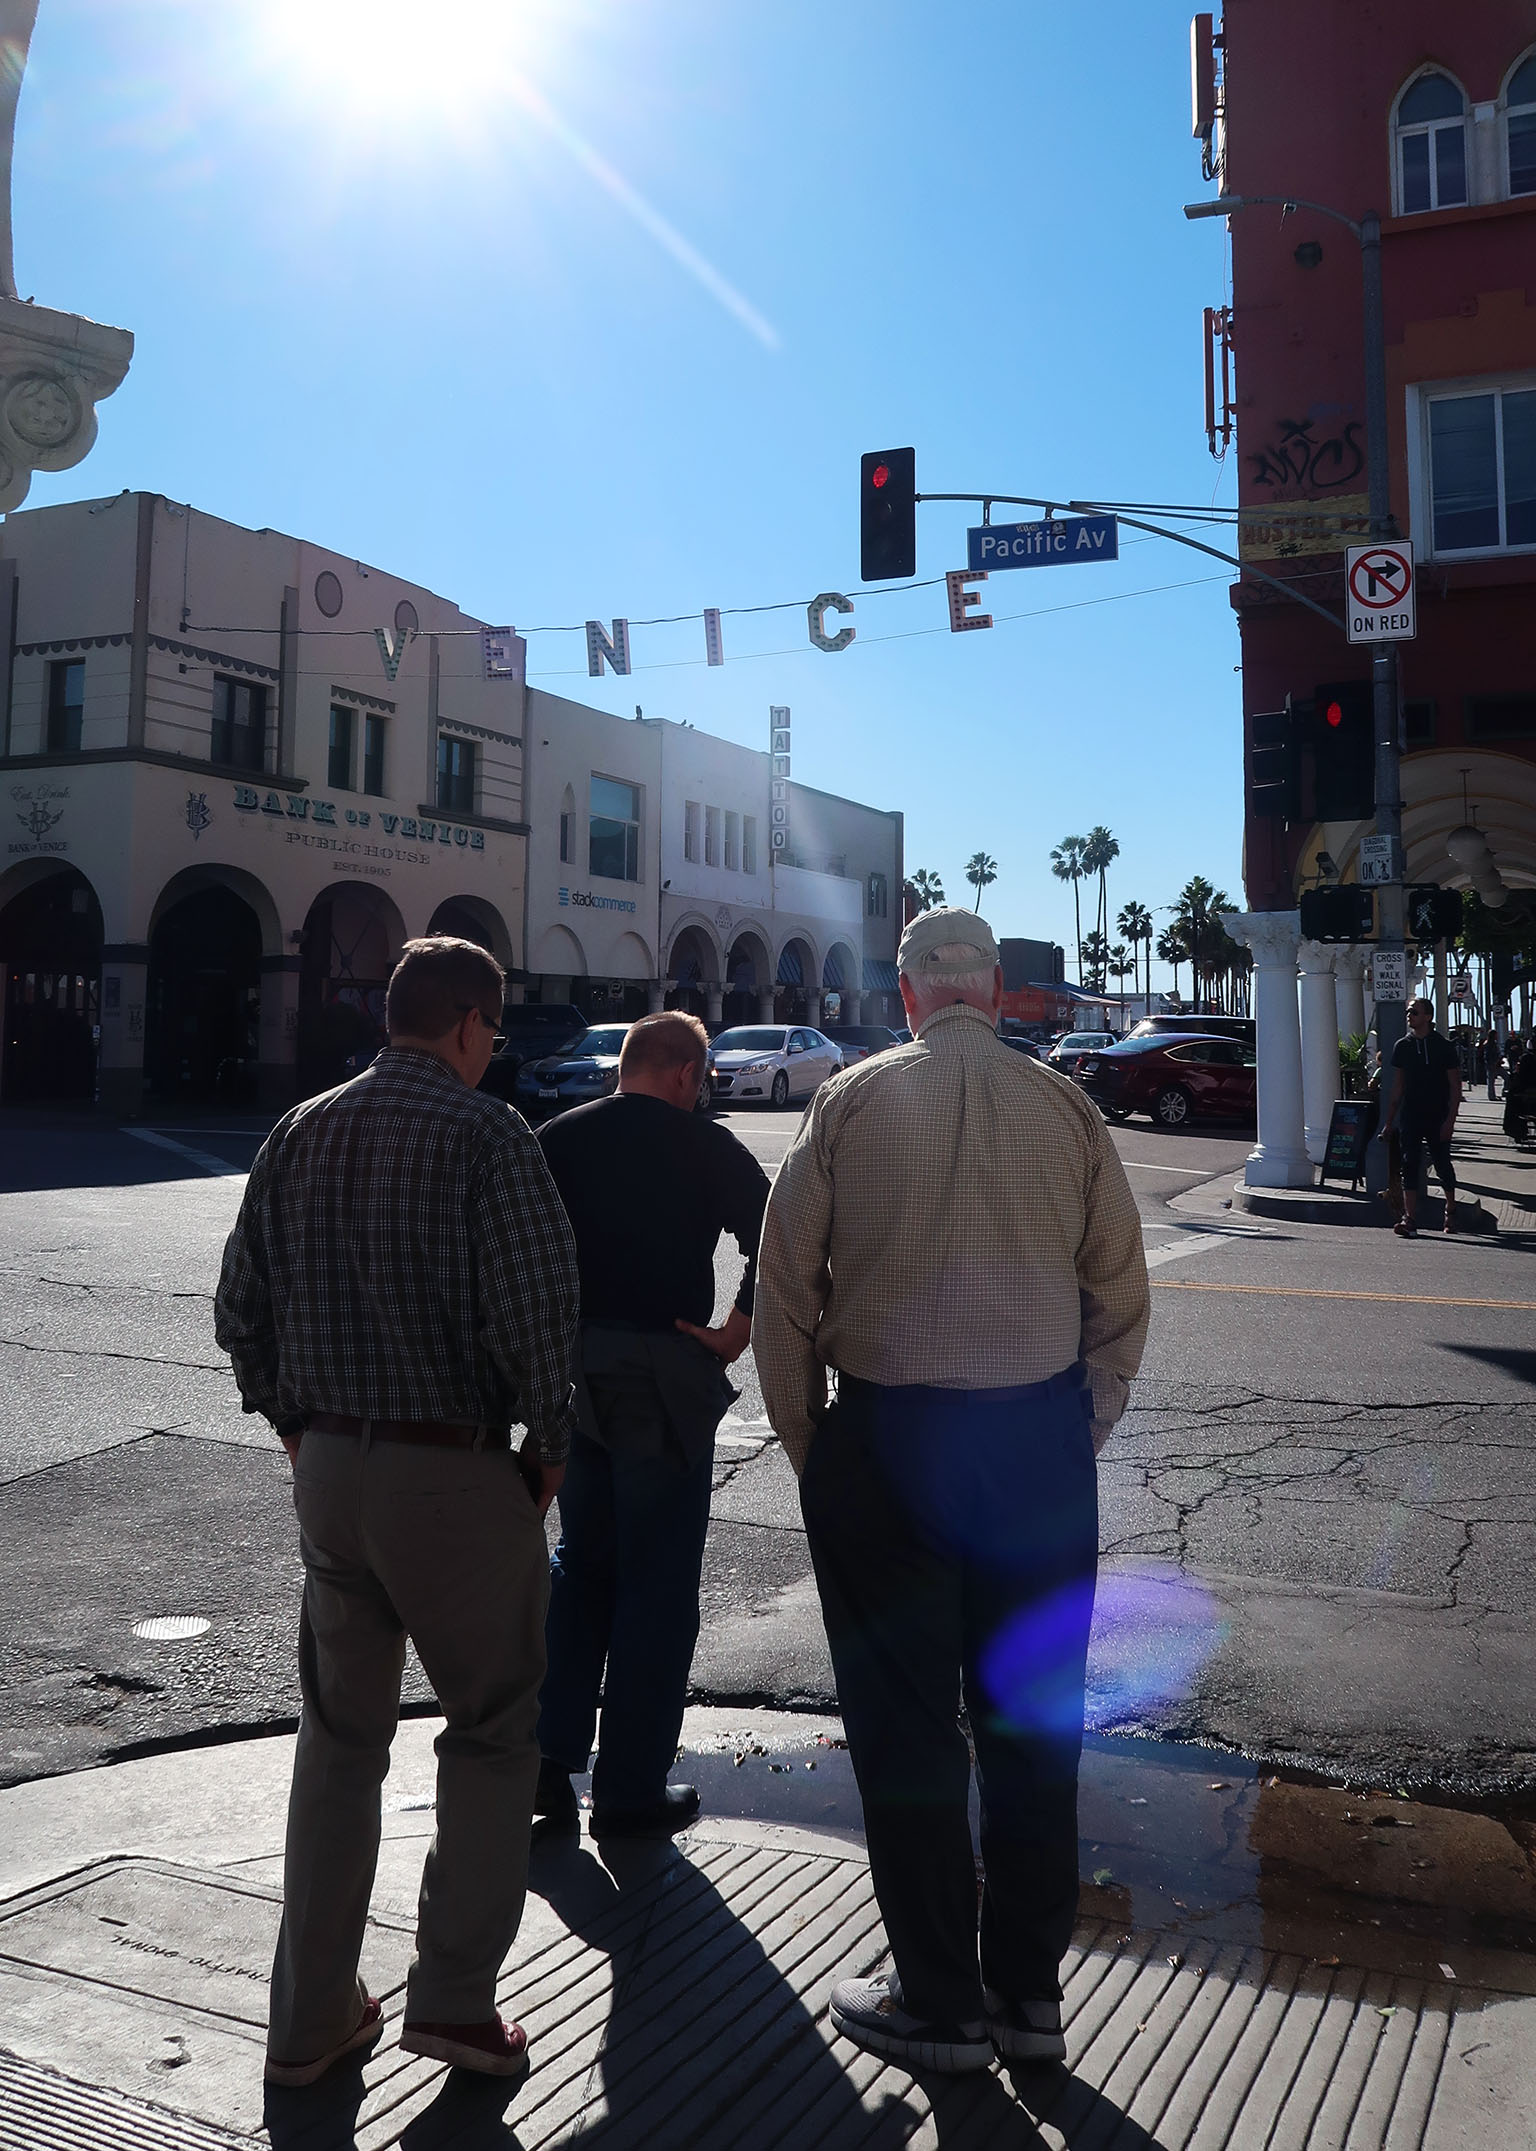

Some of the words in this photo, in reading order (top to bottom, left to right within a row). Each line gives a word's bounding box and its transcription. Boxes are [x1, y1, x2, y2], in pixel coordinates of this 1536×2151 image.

[981, 529, 1067, 559] Pacific
[1075, 527, 1106, 550] Av
[374, 569, 994, 681] VENICE
[1353, 616, 1374, 633] ON
[1380, 614, 1410, 631] RED
[233, 785, 338, 825] BANK
[379, 812, 486, 850] VENICE
[285, 832, 361, 854] PUBLIC
[363, 845, 431, 865] HOUSE
[1362, 861, 1375, 880] OK
[571, 890, 637, 913] stackcommerce
[1376, 954, 1402, 963] CROSS
[1376, 981, 1404, 989] SIGNAL
[1380, 971, 1401, 979] WALK
